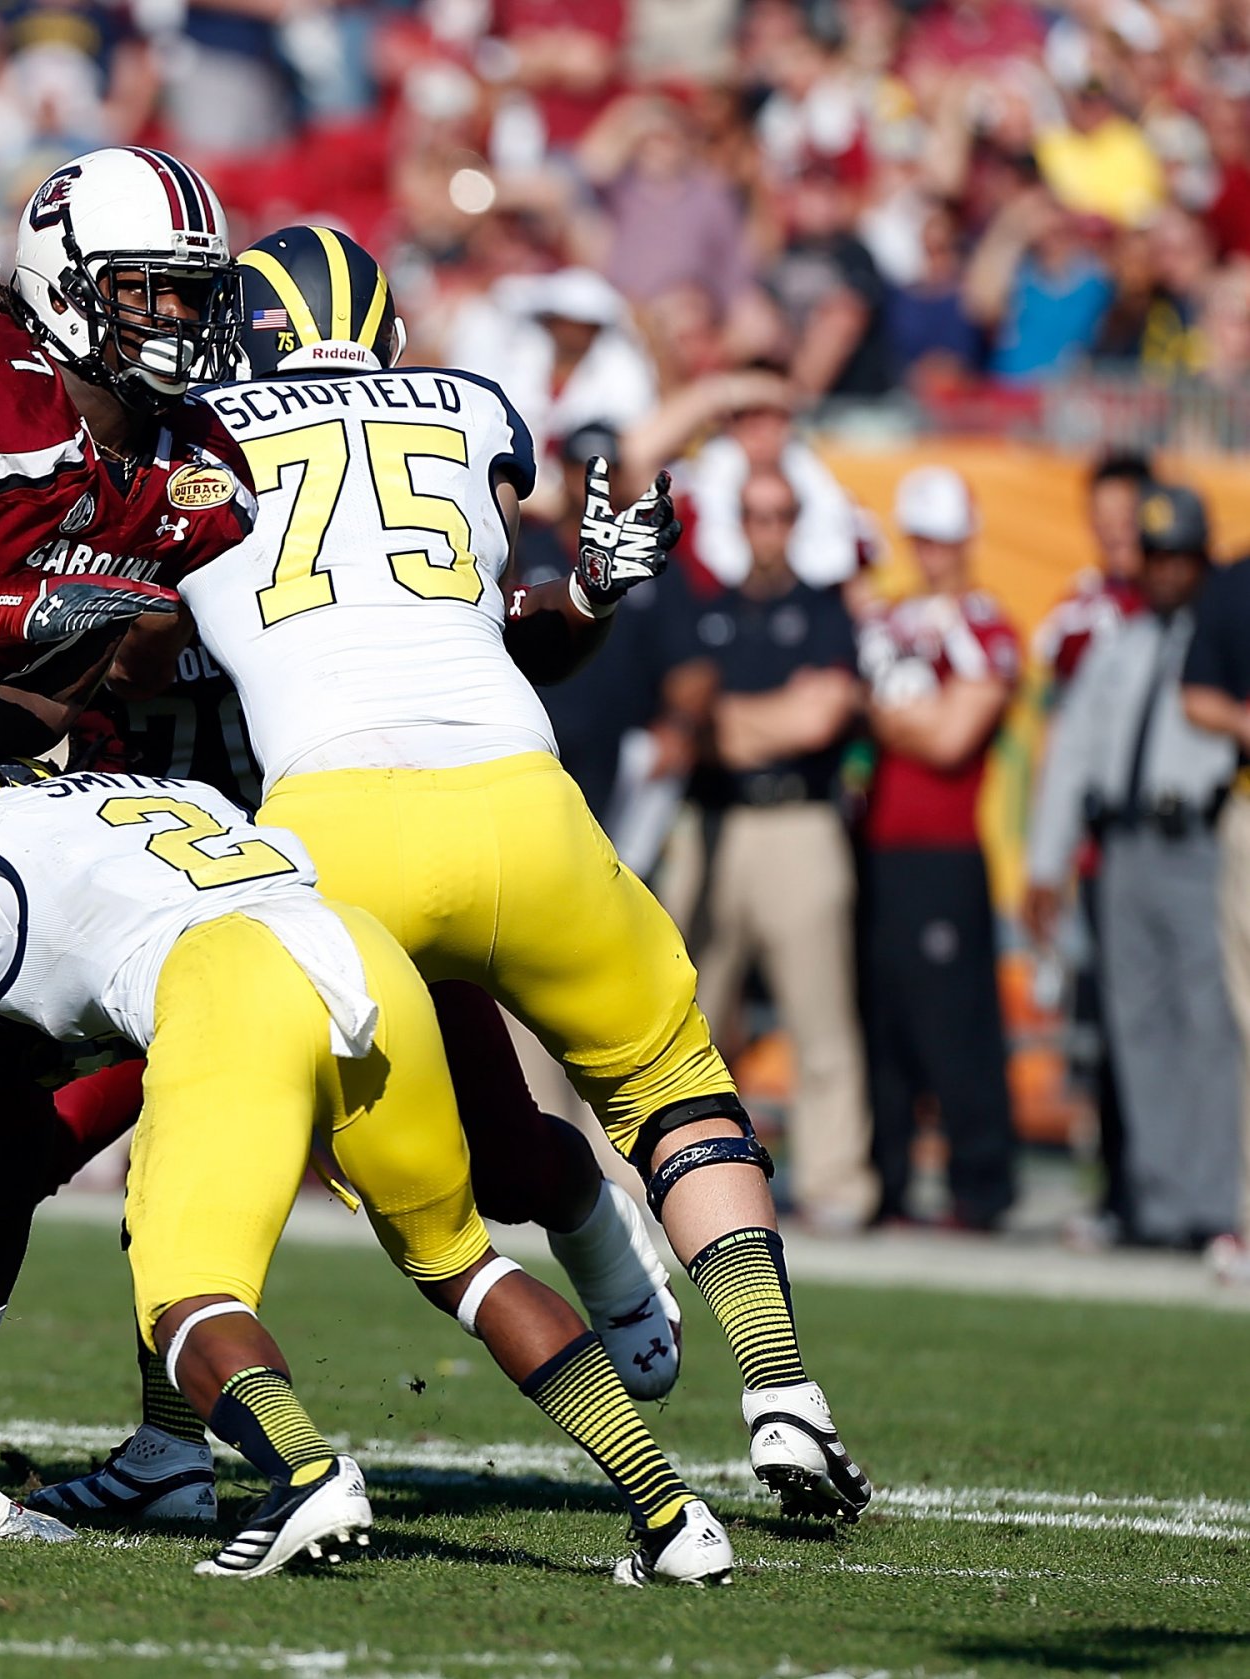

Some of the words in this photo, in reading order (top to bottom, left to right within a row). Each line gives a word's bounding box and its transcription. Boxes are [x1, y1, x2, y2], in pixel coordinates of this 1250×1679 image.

[276, 331, 295, 351] 75
[312, 348, 366, 363] Riddell
[213, 378, 461, 430] SCHOFIELD
[174, 484, 228, 497] OUTBACK
[178, 493, 222, 502] BOWL
[237, 418, 485, 630] 75
[96, 796, 299, 891] 2
[661, 1143, 718, 1180] DONJOY
